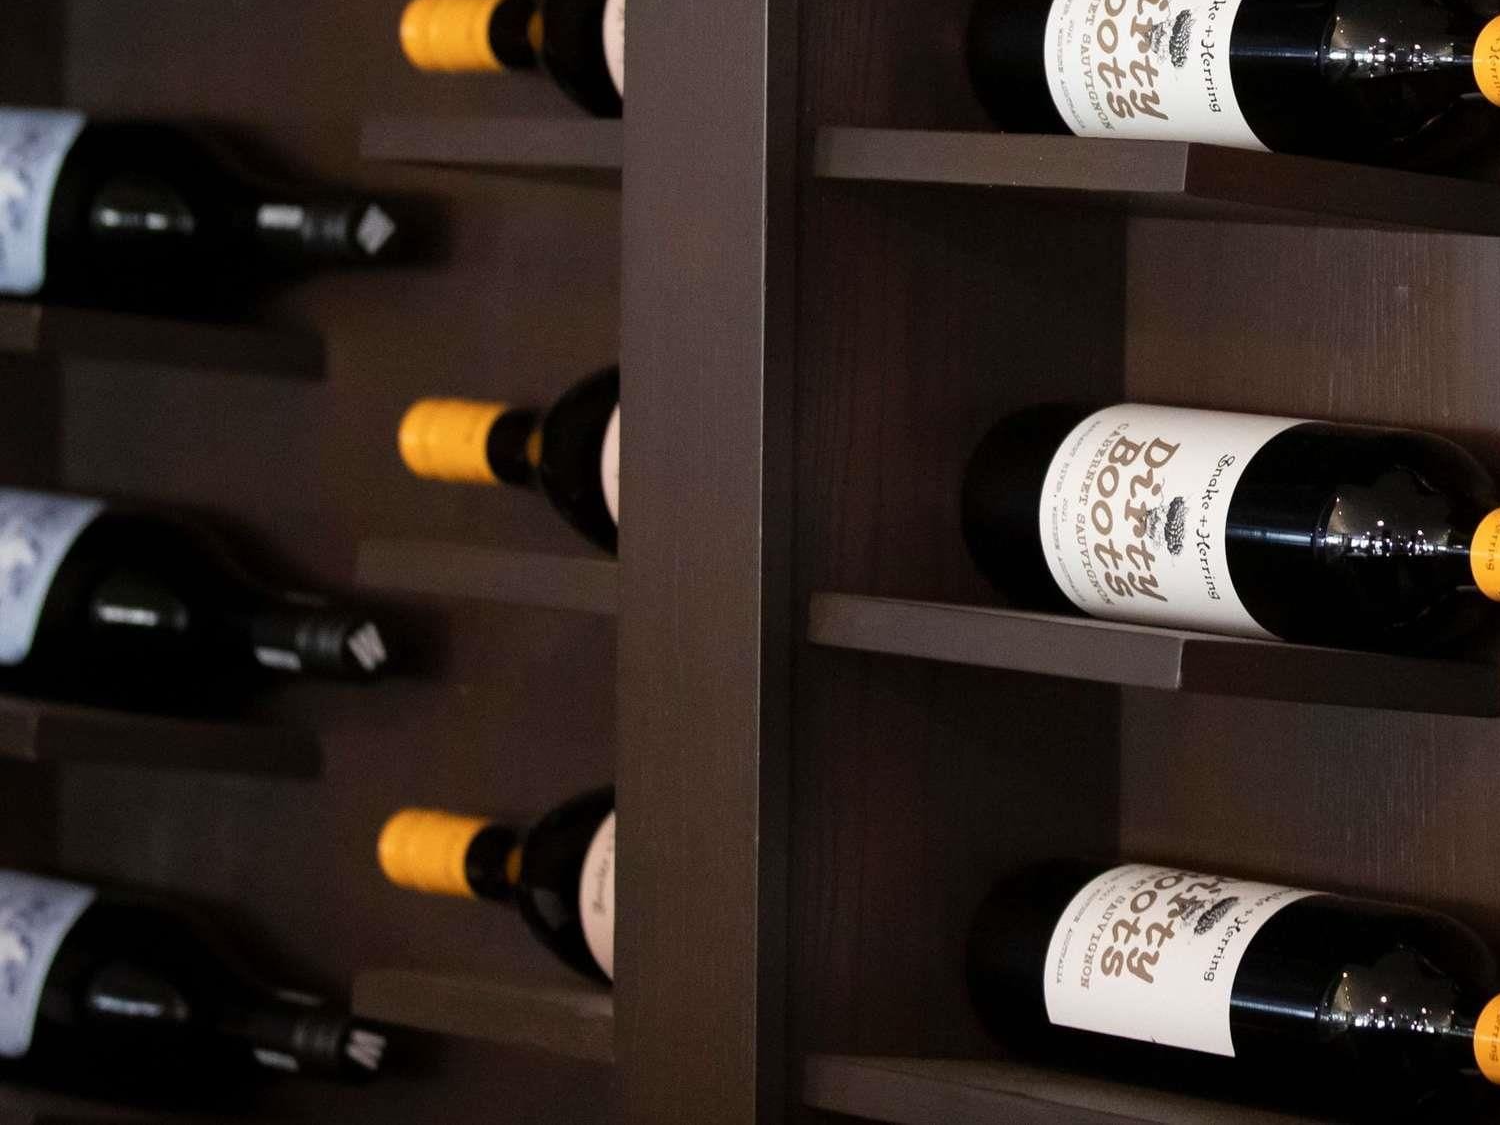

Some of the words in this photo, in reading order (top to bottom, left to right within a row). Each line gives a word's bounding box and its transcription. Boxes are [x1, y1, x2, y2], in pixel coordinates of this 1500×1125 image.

[1080, 33, 1117, 131] SAUVIGNON
[1201, 39, 1222, 114] Herring
[1077, 422, 1130, 507] CABERNET
[1201, 454, 1236, 511] Snake
[1074, 512, 1115, 607] SAUVIGNON
[1090, 435, 1147, 598] Boots
[1123, 436, 1182, 603] Dirty
[1196, 528, 1222, 601] Herring
[1080, 895, 1127, 991] SAUVIGNON
[1203, 917, 1251, 983] Herring
